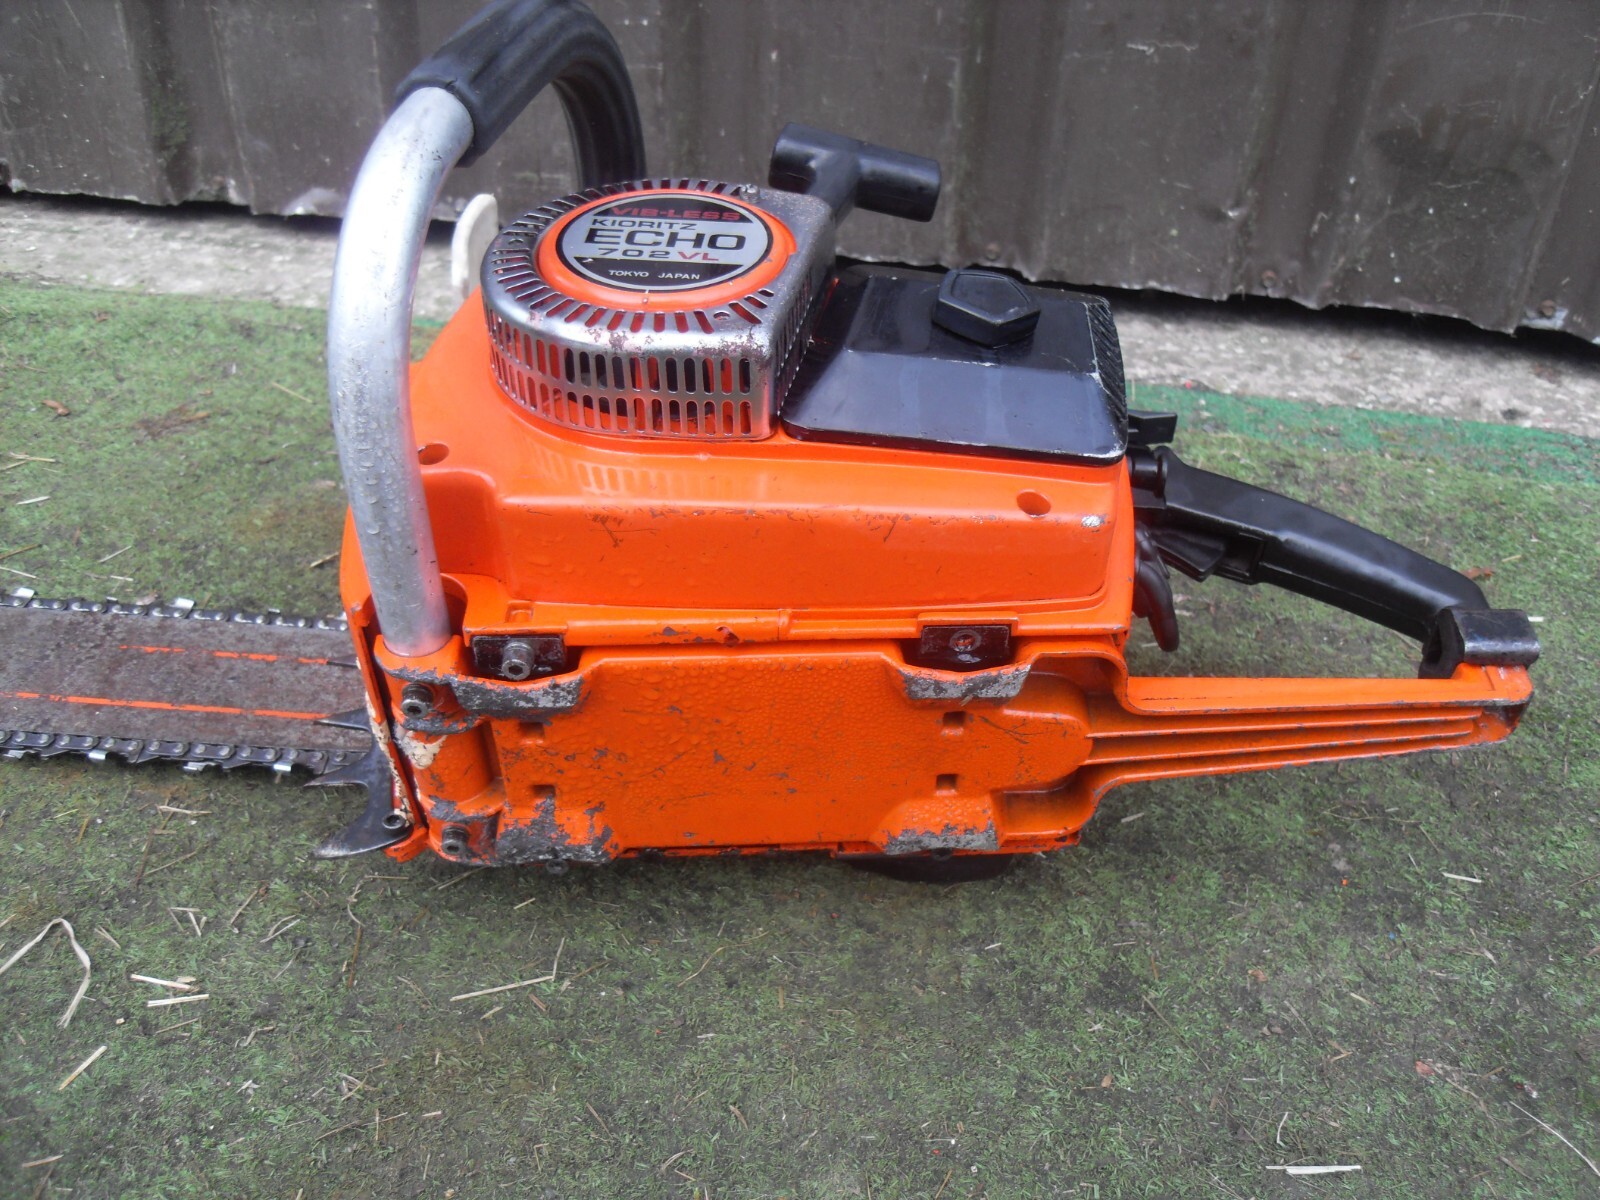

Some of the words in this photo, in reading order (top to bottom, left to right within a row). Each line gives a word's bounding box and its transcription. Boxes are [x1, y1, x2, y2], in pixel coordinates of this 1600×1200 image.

[611, 207, 741, 220] VIB-LESS
[592, 218, 697, 230] KIORITZ
[585, 228, 746, 250] ECHO
[608, 269, 649, 277] TOKYO
[658, 272, 700, 280] JAPAN
